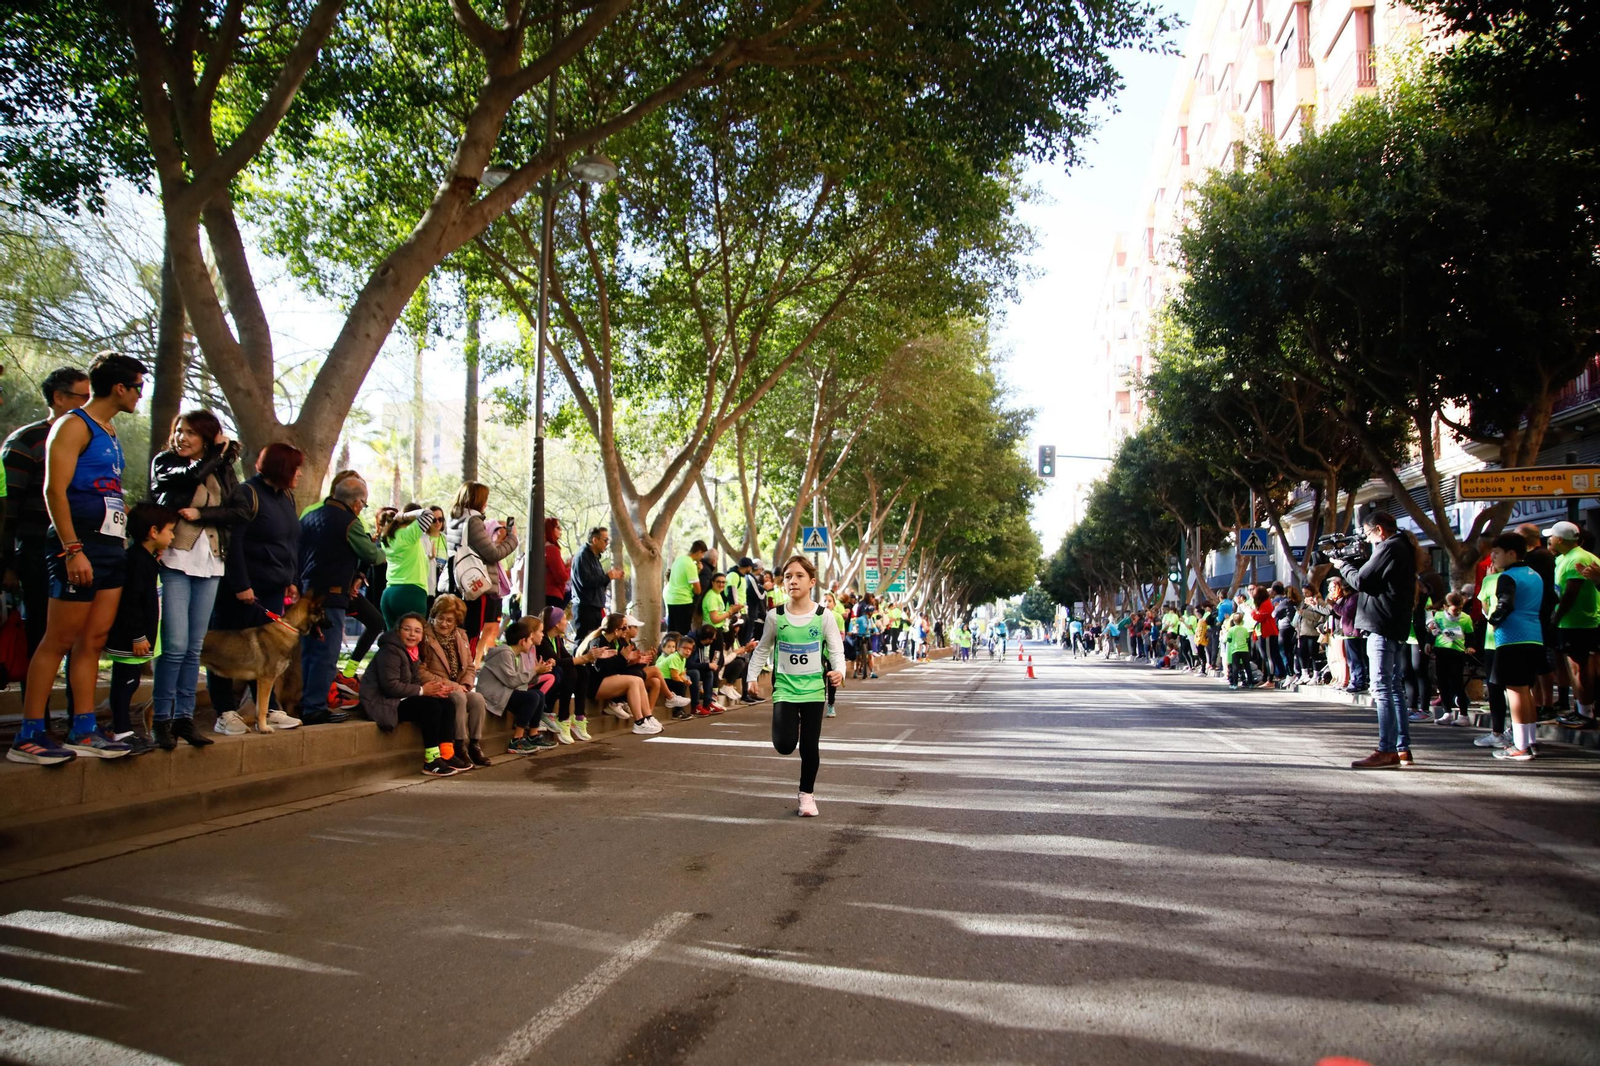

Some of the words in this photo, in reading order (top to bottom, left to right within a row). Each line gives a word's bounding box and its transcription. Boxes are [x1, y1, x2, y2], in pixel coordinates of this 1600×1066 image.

[1463, 475, 1505, 484] estación
[1512, 474, 1566, 483] intermodal
[1510, 486, 1515, 494] y
[789, 654, 809, 665] 66
